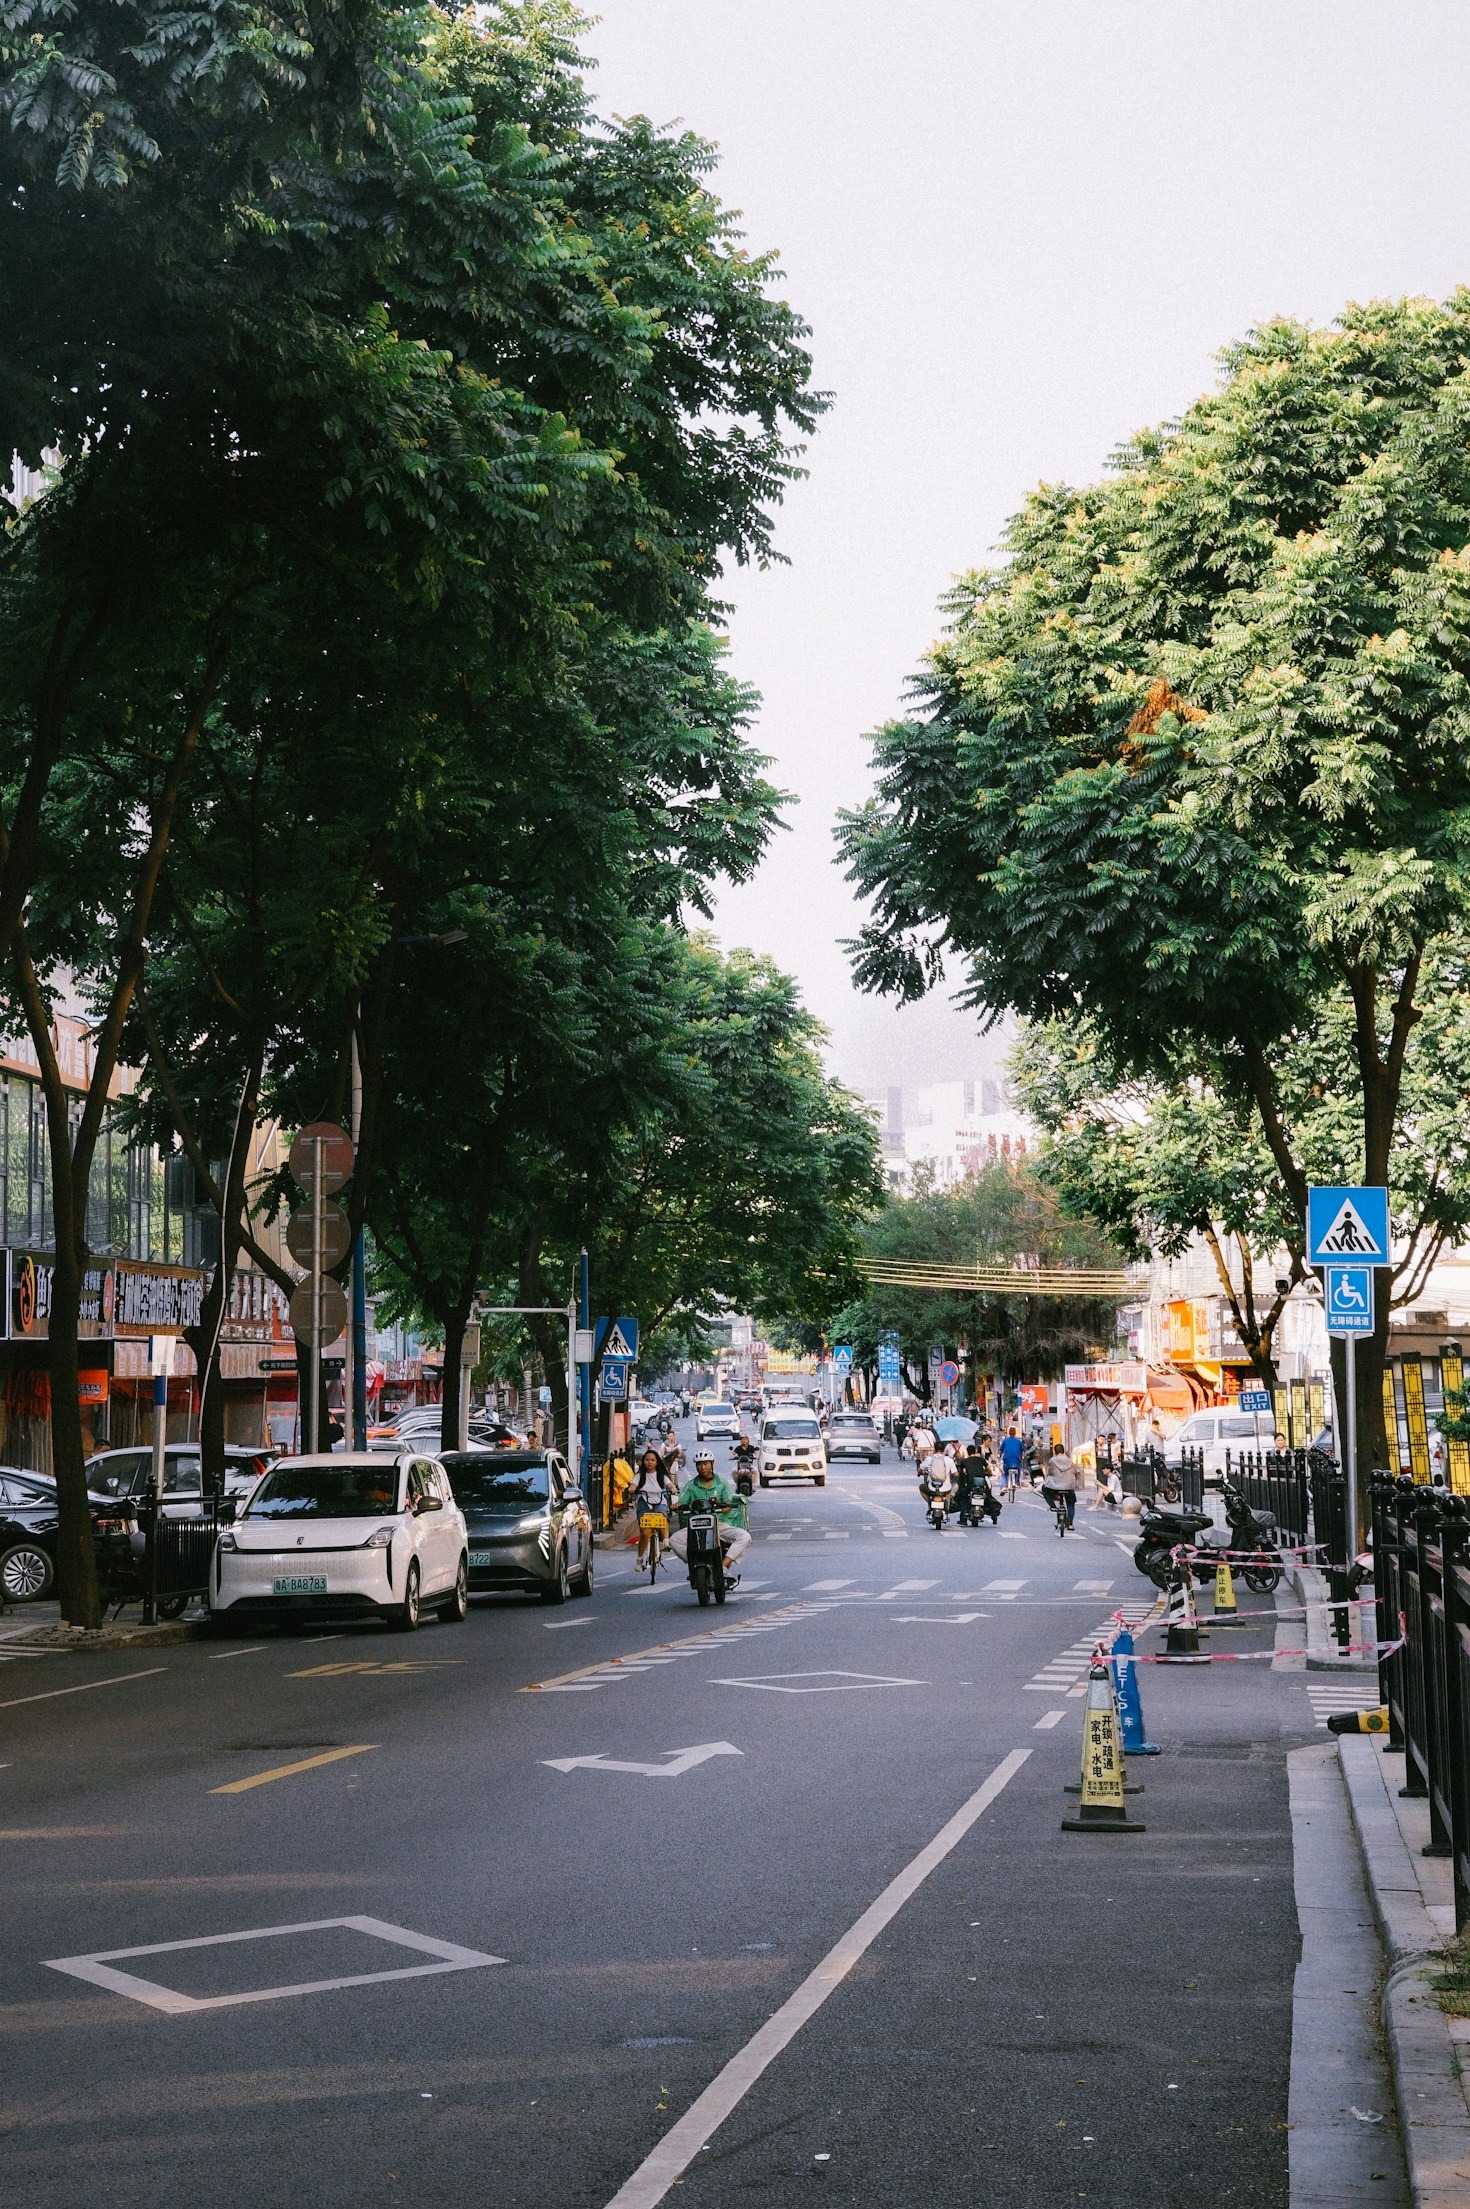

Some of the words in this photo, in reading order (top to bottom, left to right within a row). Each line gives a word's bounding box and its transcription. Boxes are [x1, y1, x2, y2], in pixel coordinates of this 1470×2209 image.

[1330, 1316, 1370, 1326] 无障碍通道
[1242, 1393, 1268, 1404] 出口
[1244, 1402, 1267, 1410] EXIT
[1218, 1568, 1226, 1604] 禁止停车
[1090, 1720, 1103, 1778] 家电·水电
[1102, 1715, 1114, 1770] 开锁·疏通
